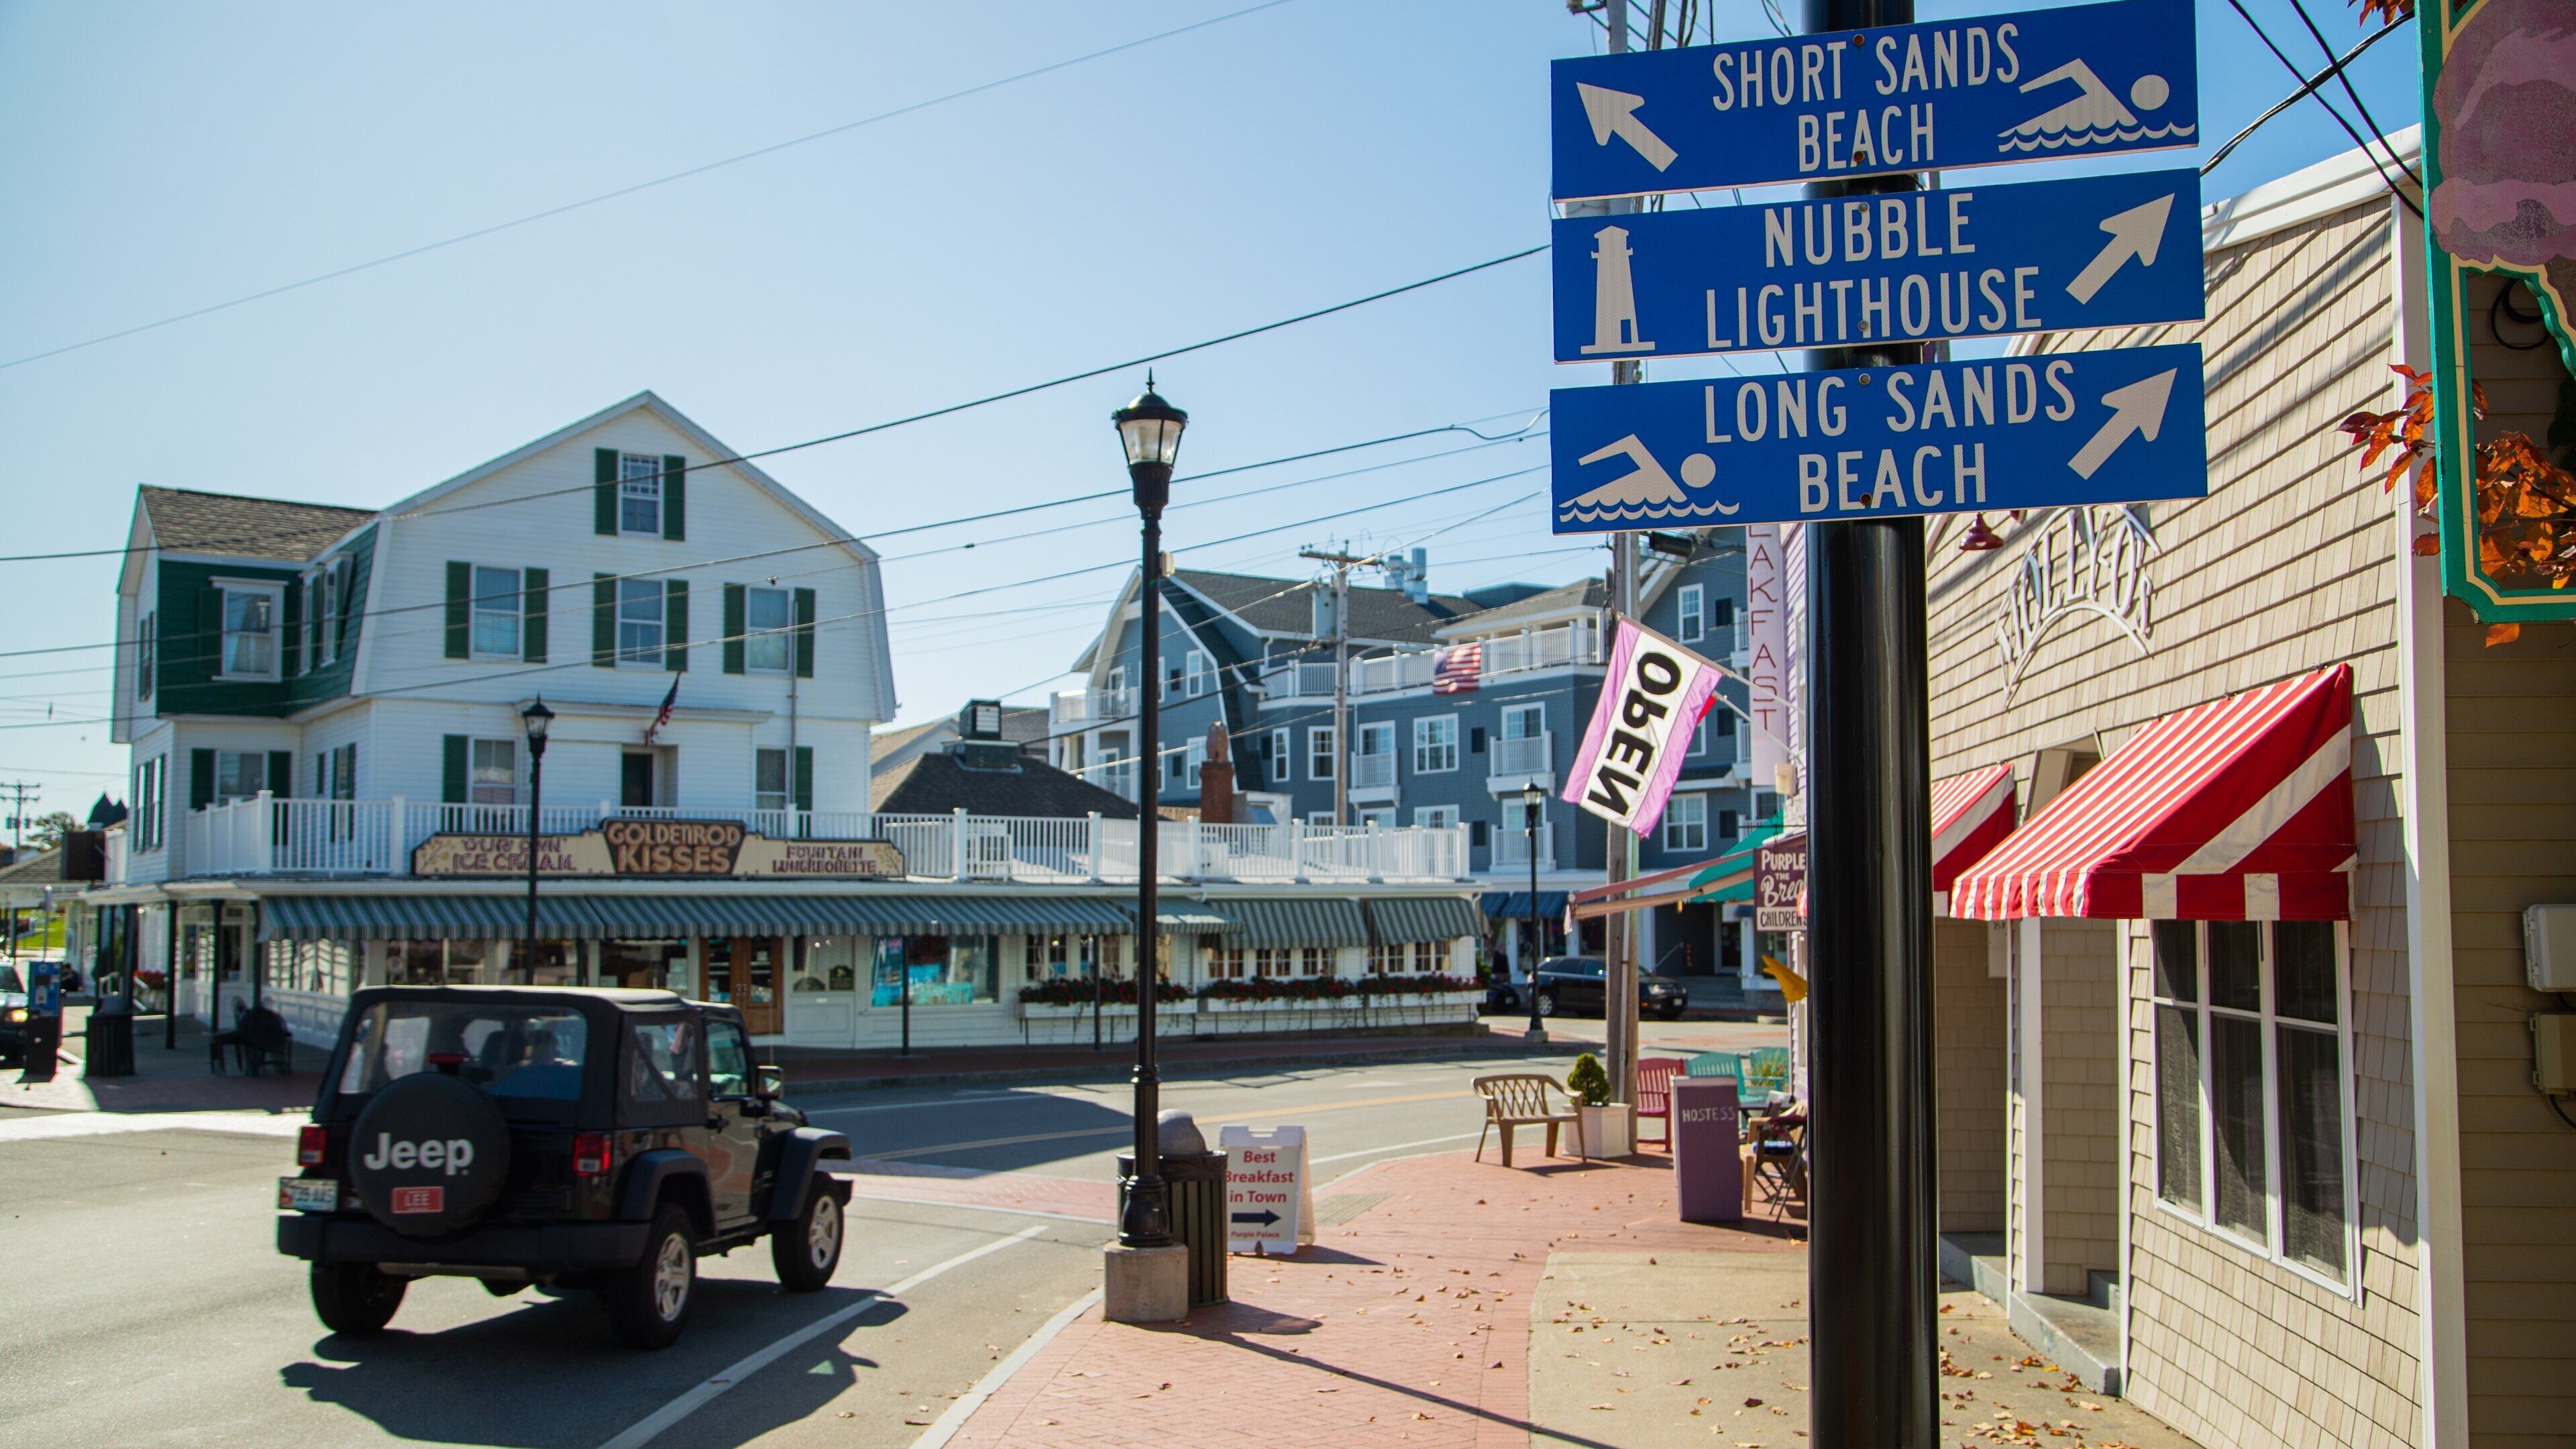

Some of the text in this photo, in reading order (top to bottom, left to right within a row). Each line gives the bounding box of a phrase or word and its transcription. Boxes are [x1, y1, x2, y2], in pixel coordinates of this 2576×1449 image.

[1713, 23, 2019, 111] SHORT SANDS
[1799, 103, 1934, 172] BEACH
[1765, 193, 1976, 268] NUBBLE
[1707, 266, 2041, 348] LIGHTHOUSE
[1705, 360, 2075, 443] LONG SANDS
[1799, 443, 1986, 513] BEACH
[464, 838, 513, 853] OUR
[606, 821, 741, 848] GOLDENROD
[452, 853, 488, 871] ICE
[616, 844, 731, 873] KISSES
[787, 845, 864, 859] FOUNTAIN
[1761, 849, 1806, 871] PURPLE
[1774, 872, 1790, 881] THE
[1682, 1106, 1736, 1123] HOSTESS
[363, 1132, 474, 1176] Jeep
[1244, 1150, 1276, 1163] Best
[405, 1192, 430, 1207] LEE
[1229, 1190, 1287, 1203] in Town
